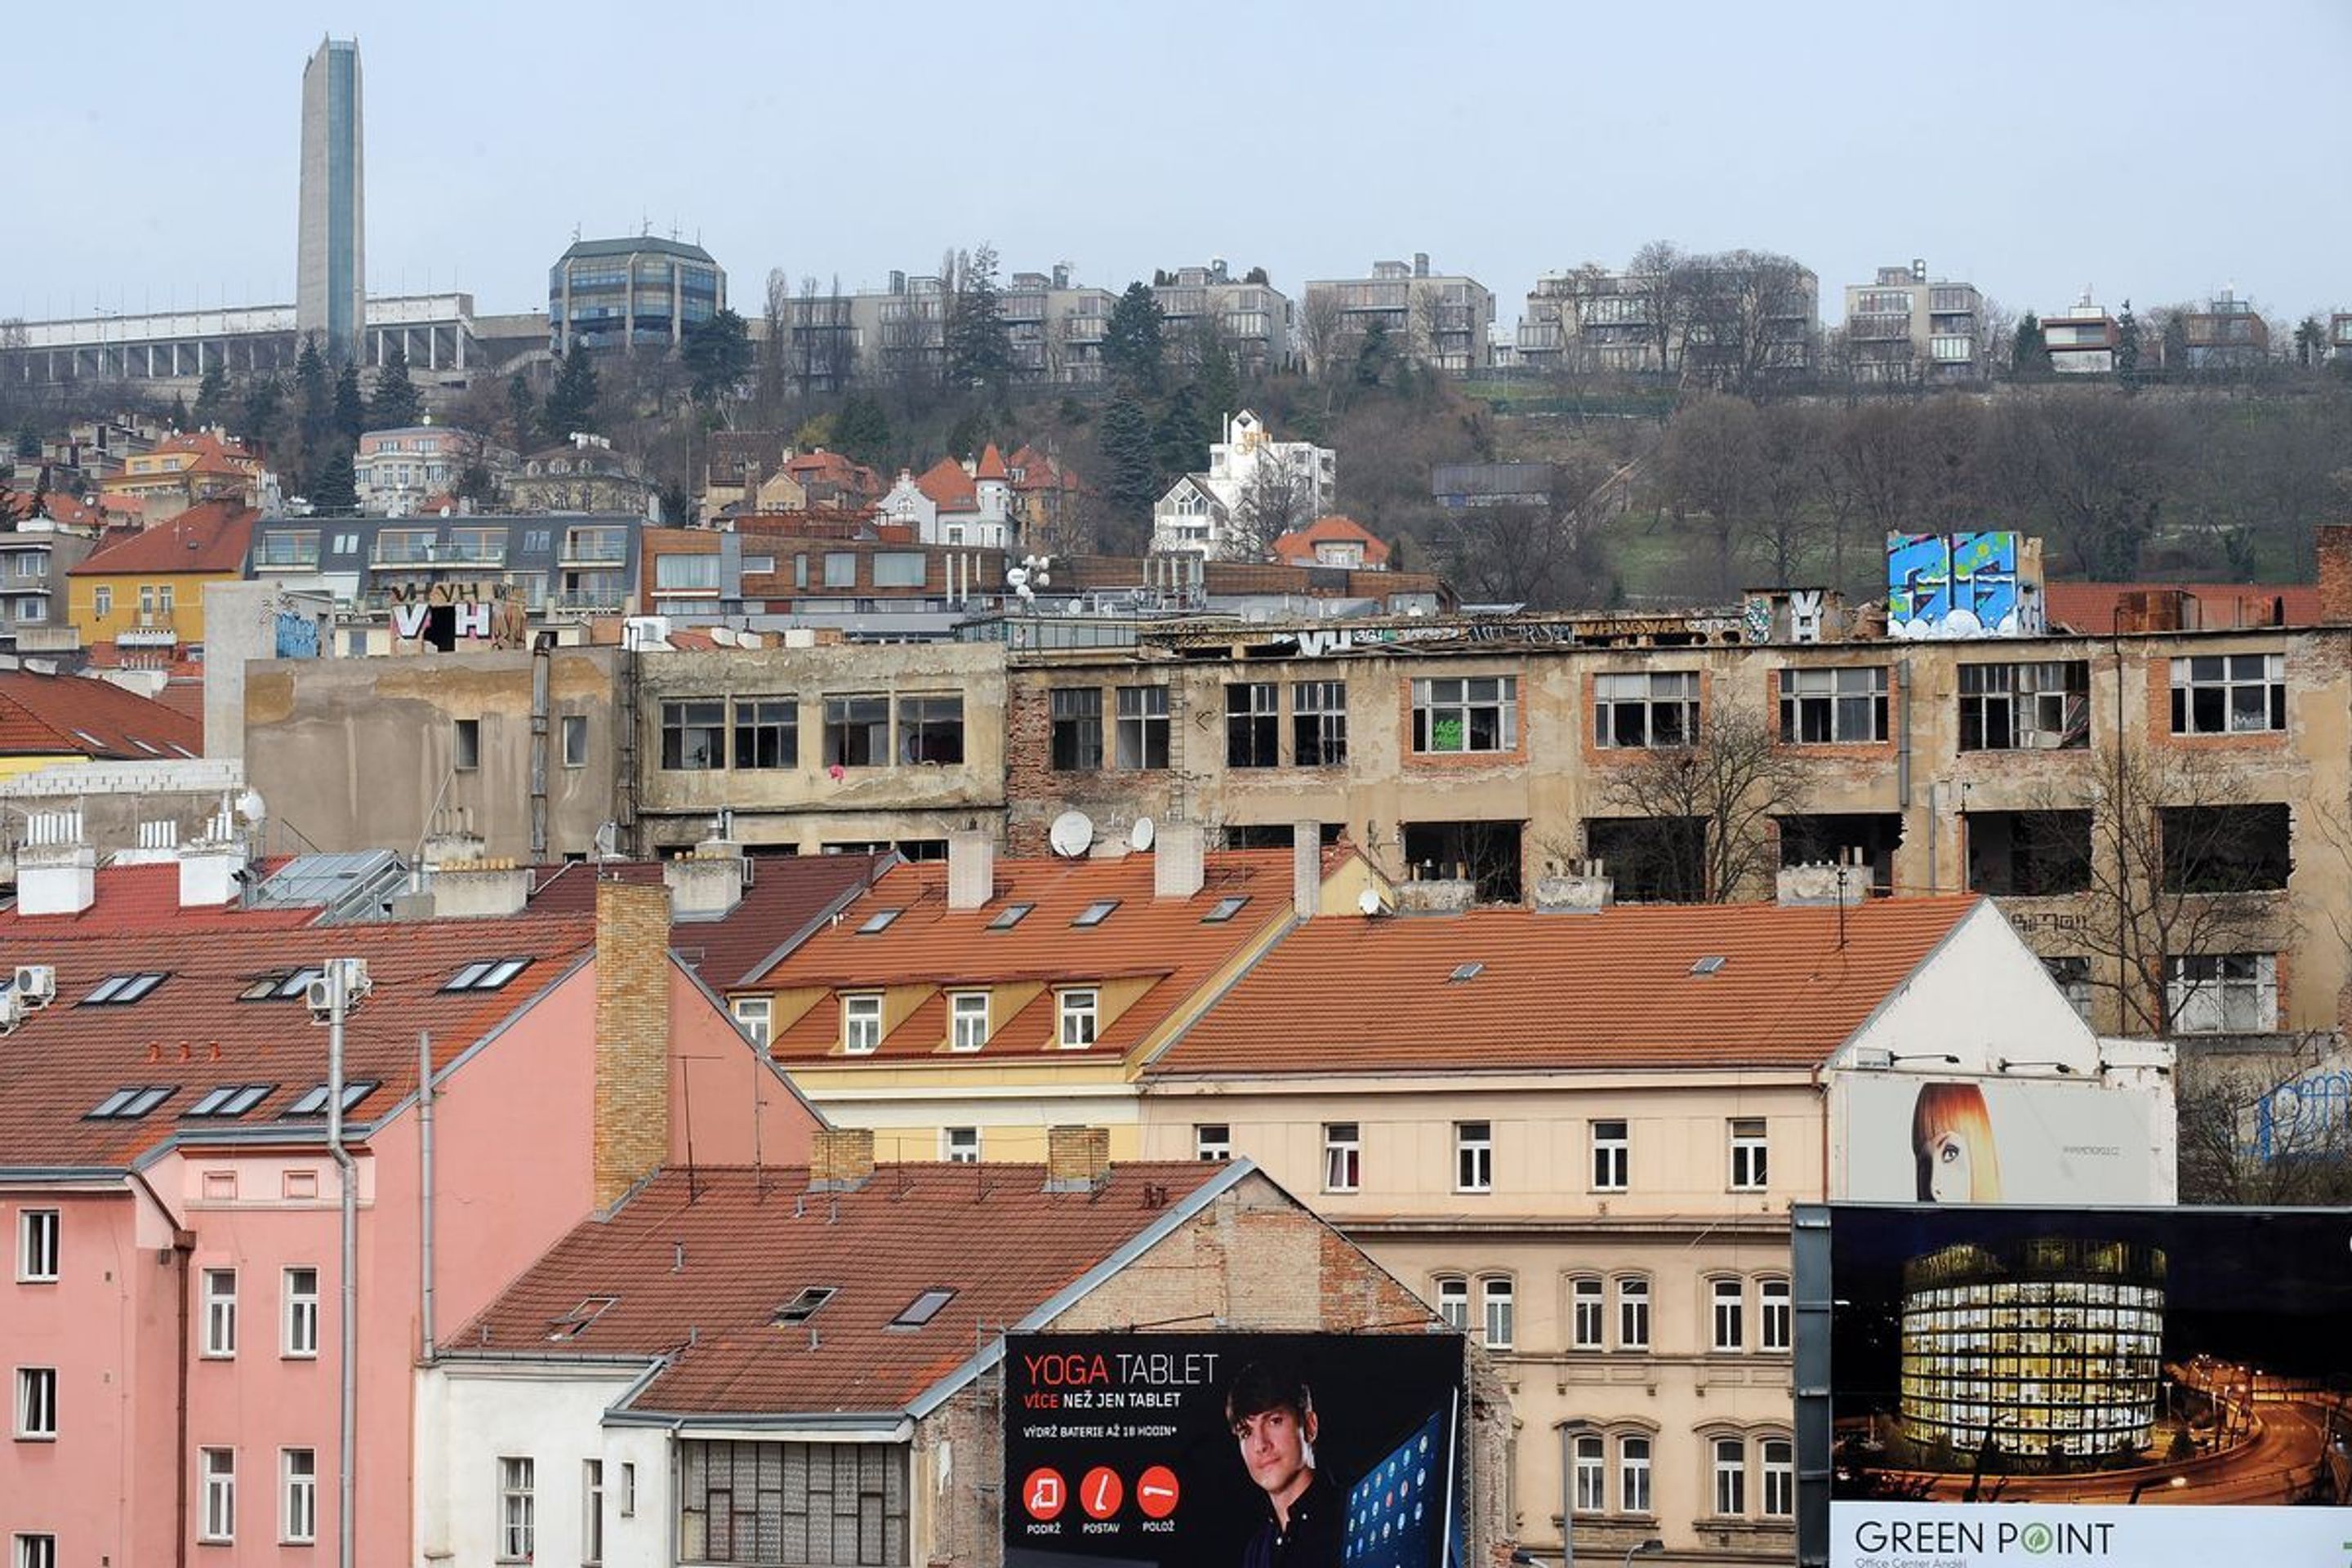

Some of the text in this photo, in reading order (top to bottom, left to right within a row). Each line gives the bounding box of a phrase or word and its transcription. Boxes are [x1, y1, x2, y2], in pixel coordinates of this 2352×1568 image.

[1025, 1354, 1218, 1385] YOGA TABLET
[1024, 1390, 1181, 1409] VÍCE NEŽ JEN TABLET
[1022, 1424, 1058, 1438] VÝDRŽ
[1061, 1427, 1103, 1438] BATERIE
[1106, 1423, 1120, 1437] AŽ
[1027, 1521, 1175, 1535] PODRŽ POSTAV POLOŽ
[1855, 1521, 2114, 1555] GREEN POINT
[1854, 1558, 1890, 1568] Office
[1892, 1558, 1930, 1568] Center
